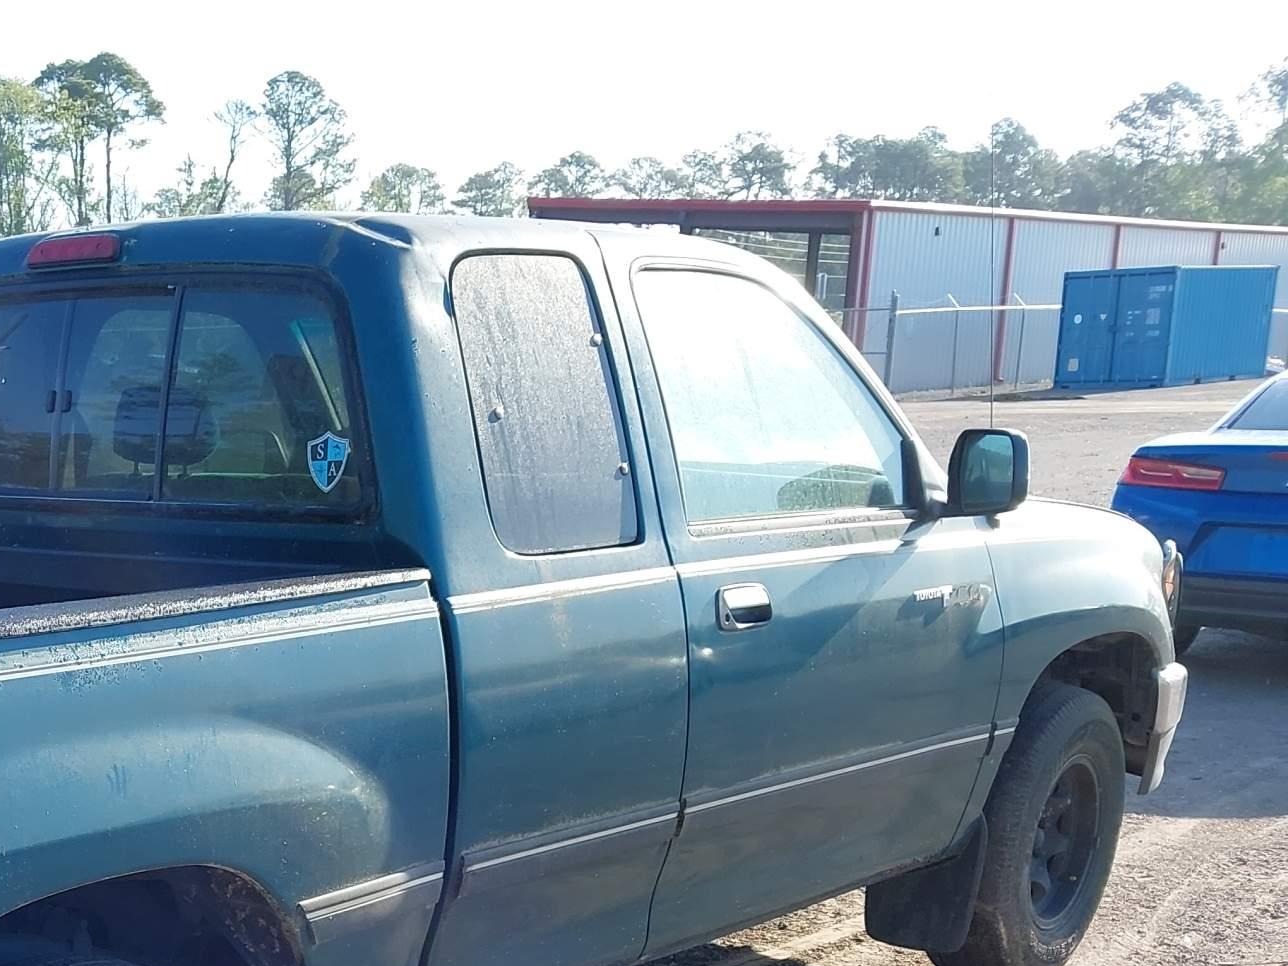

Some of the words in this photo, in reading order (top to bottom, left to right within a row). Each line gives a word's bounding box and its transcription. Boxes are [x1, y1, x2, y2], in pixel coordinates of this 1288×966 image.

[316, 443, 325, 460] S
[328, 462, 337, 476] A
[914, 586, 943, 602] TOYOTA
